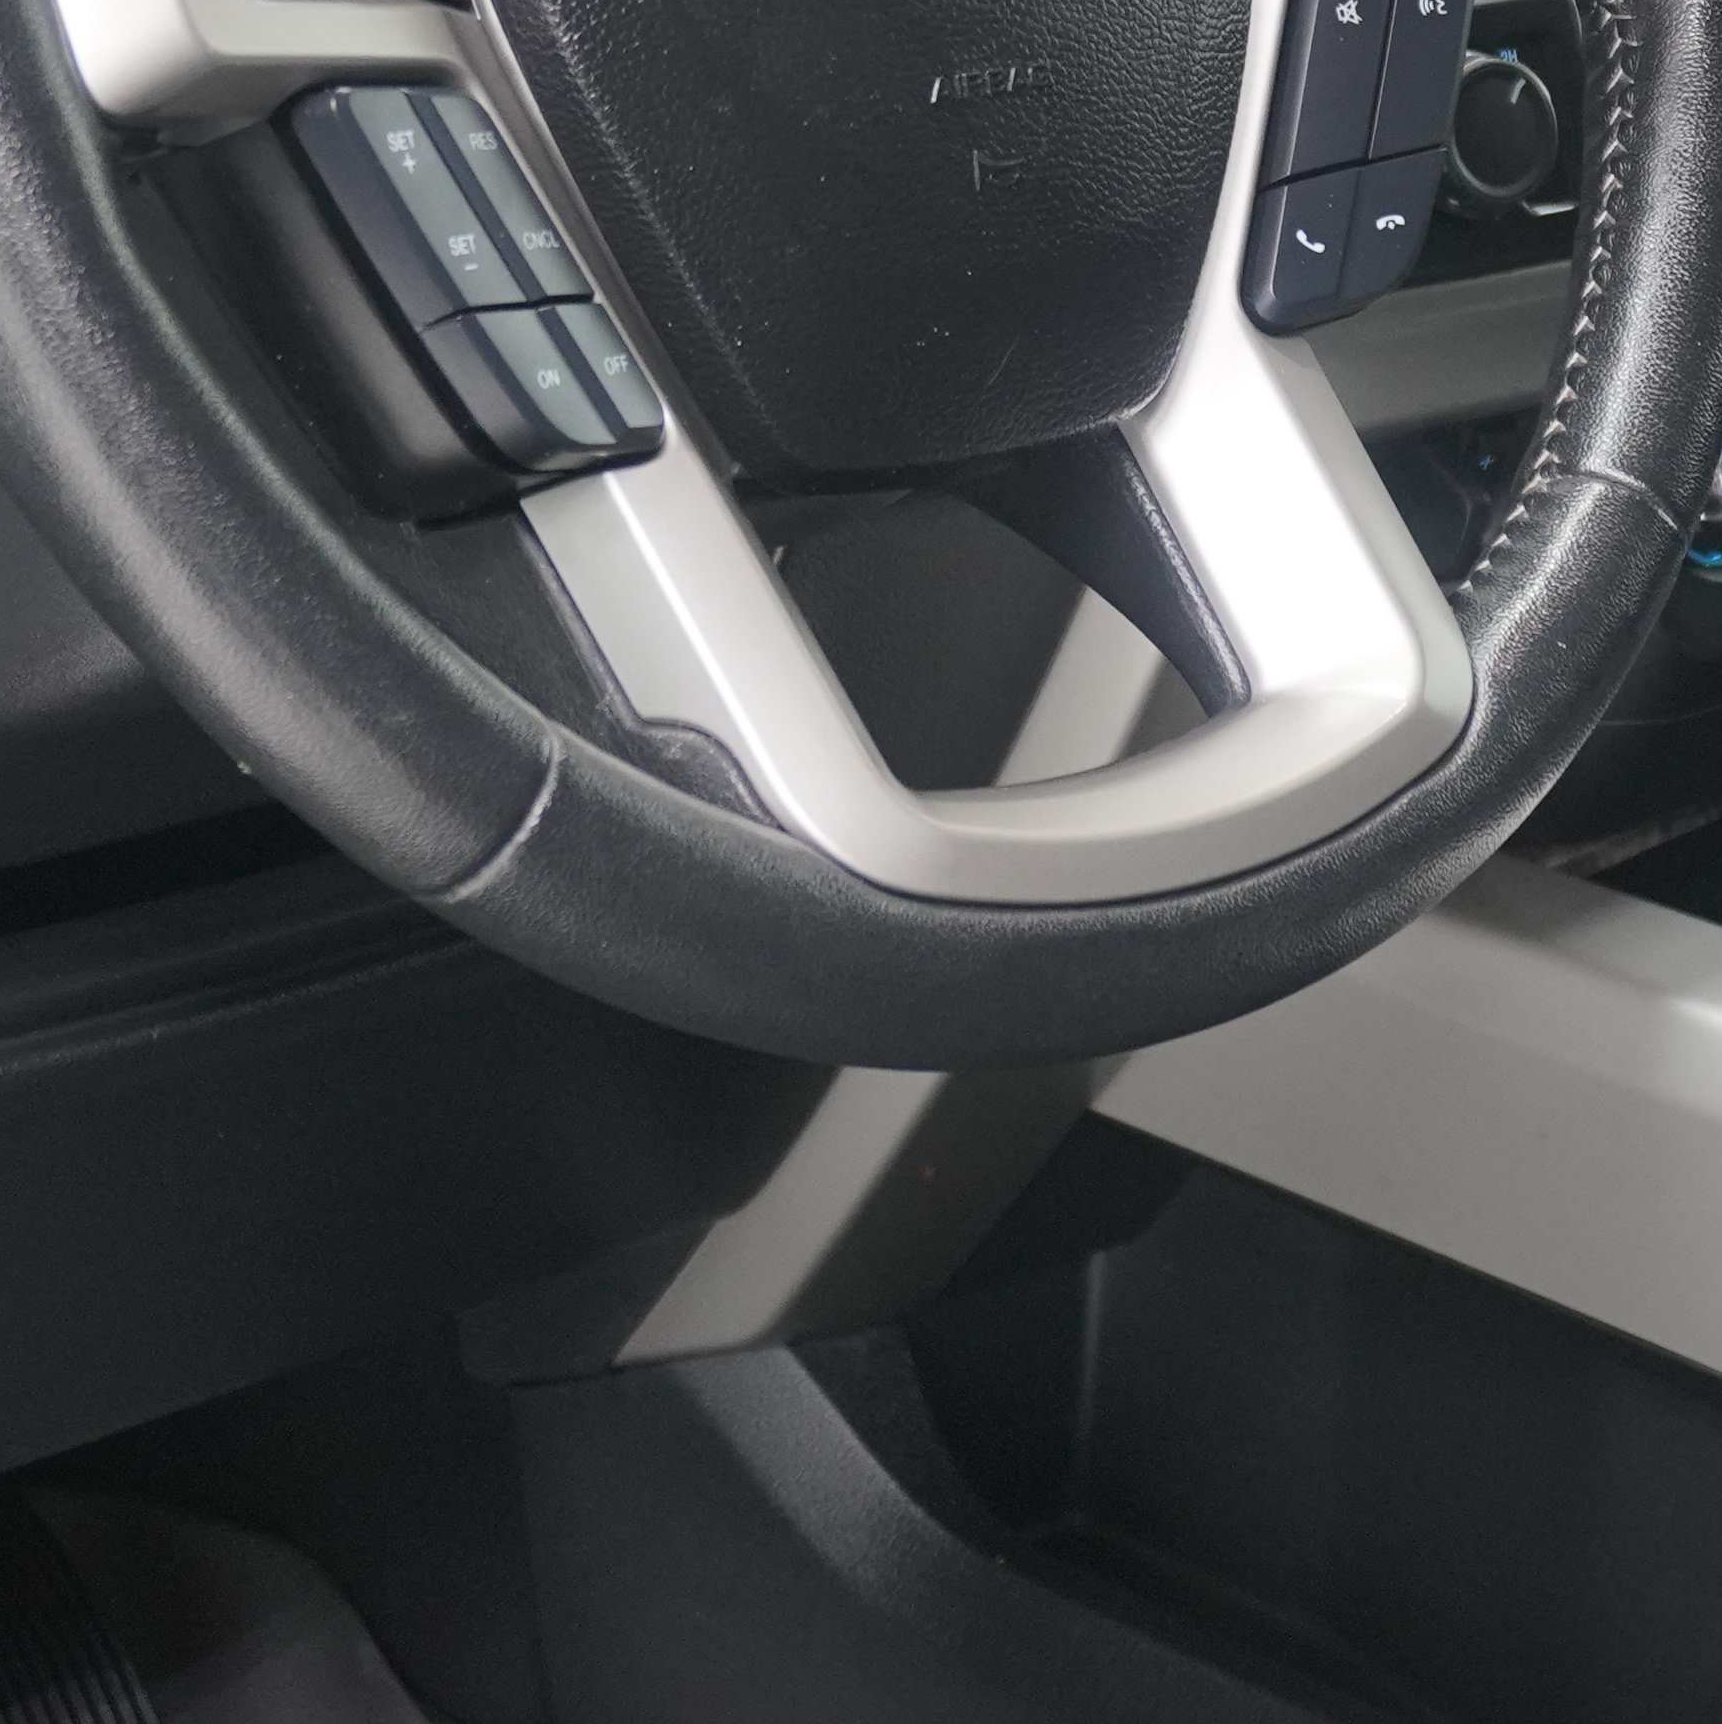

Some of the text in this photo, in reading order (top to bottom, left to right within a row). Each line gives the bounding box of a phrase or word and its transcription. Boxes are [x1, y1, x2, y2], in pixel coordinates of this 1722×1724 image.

[386, 129, 416, 153] SET
[467, 131, 497, 151] RES
[448, 233, 476, 257] SET
[522, 230, 560, 251] CNCL
[603, 354, 628, 376] OFF
[537, 368, 561, 390] ON
